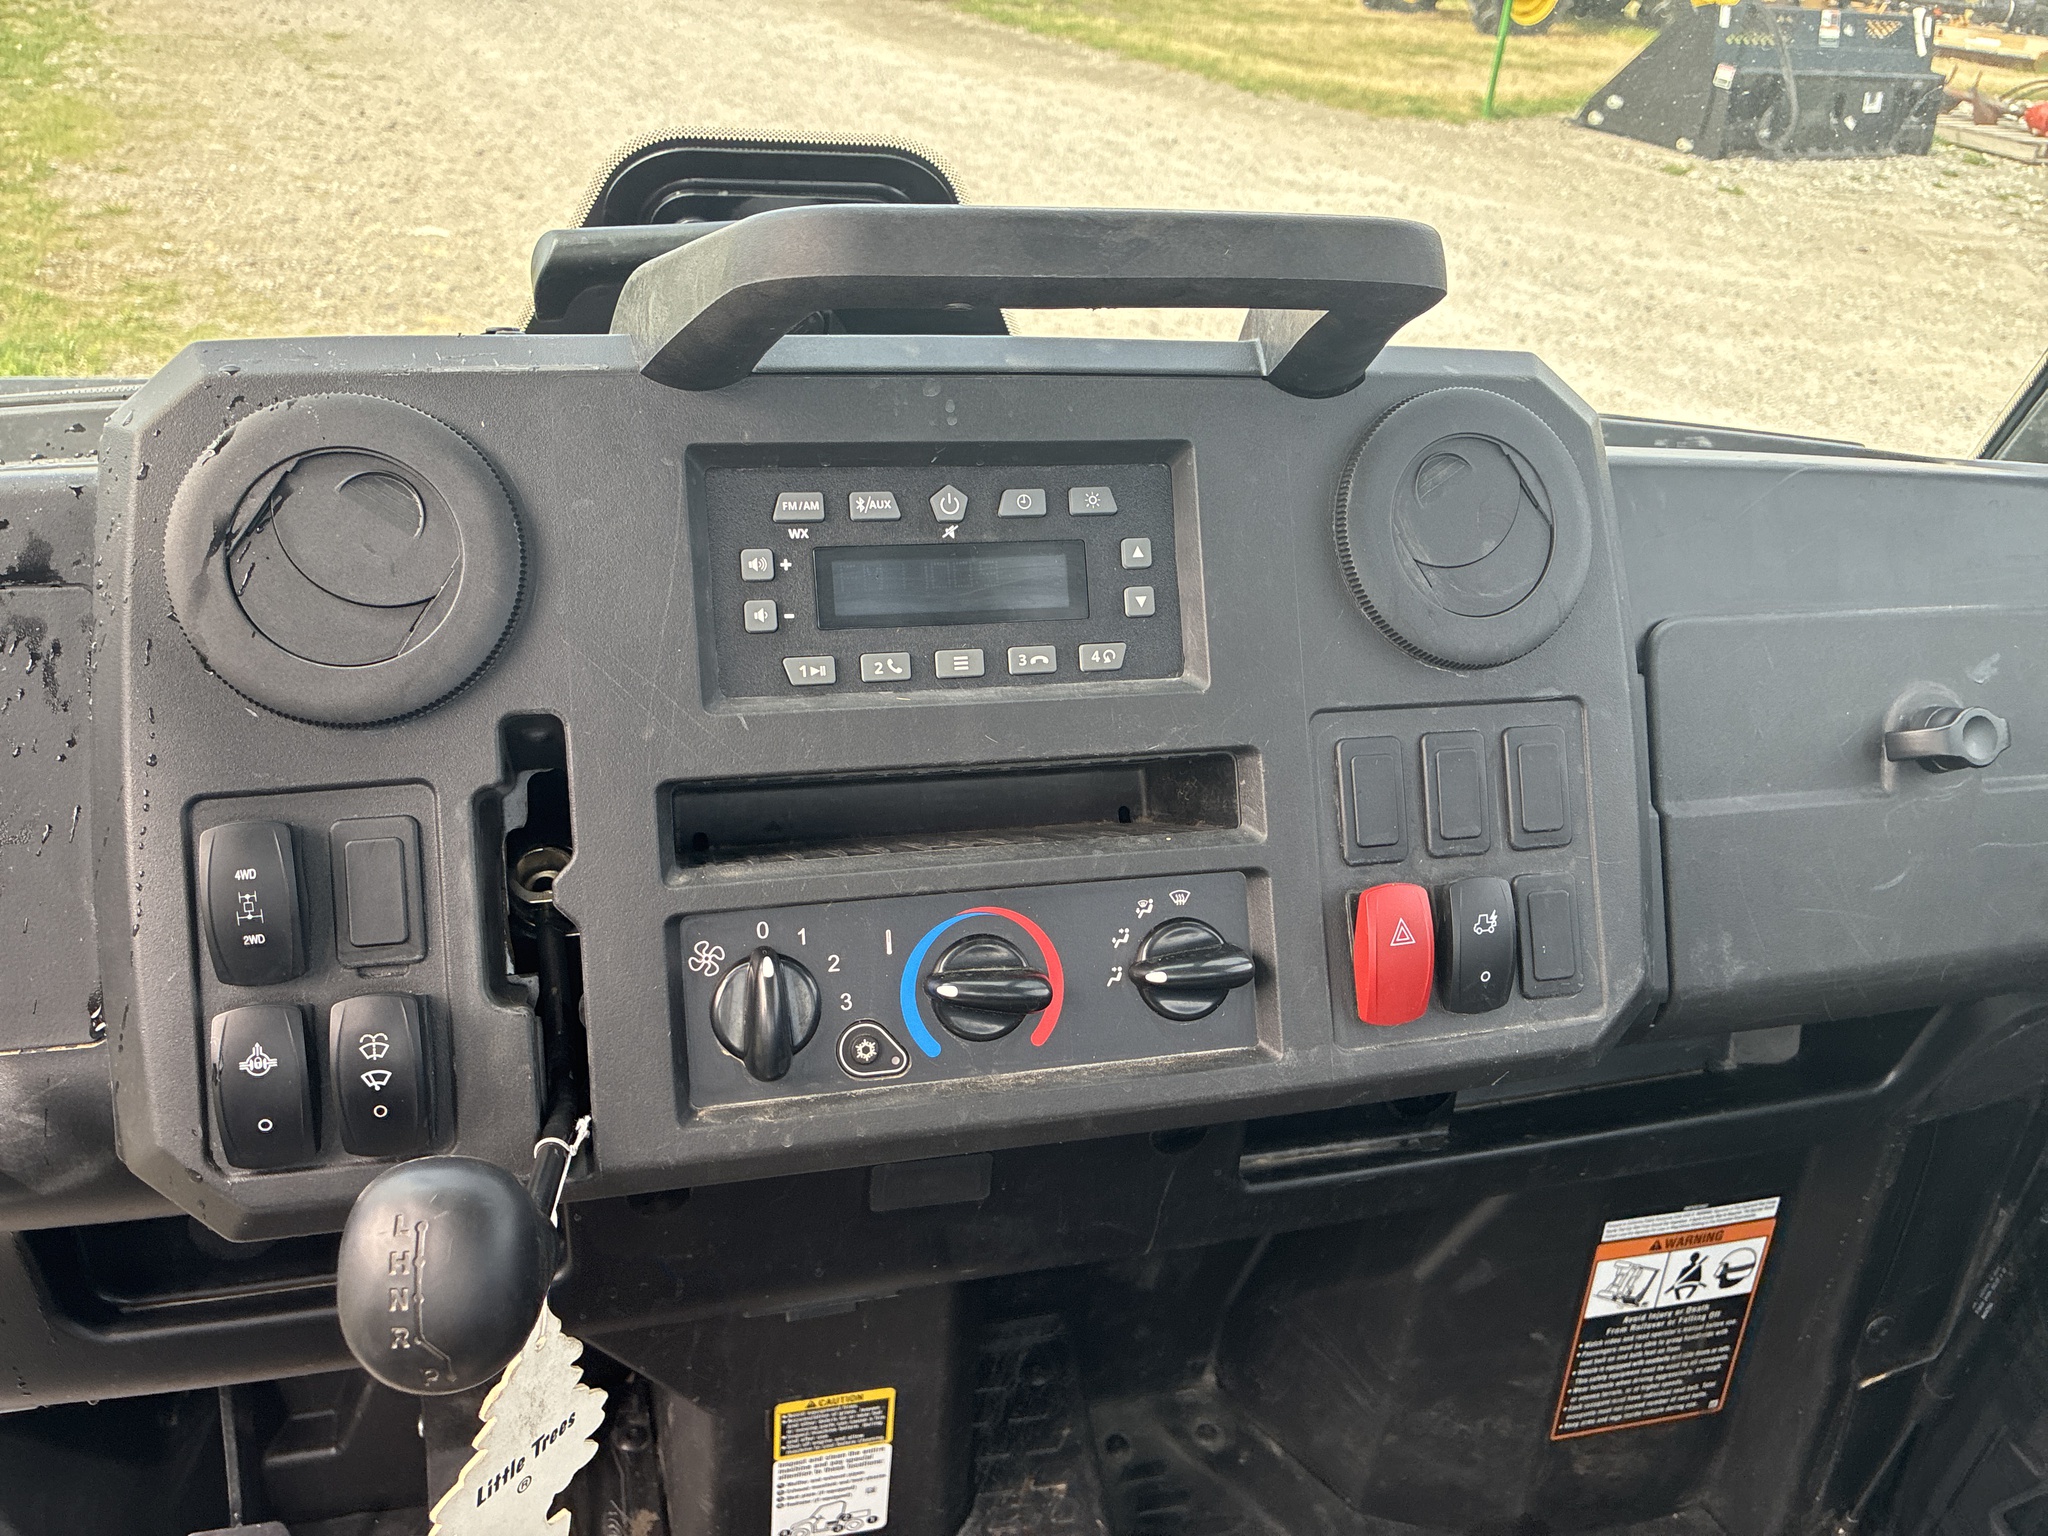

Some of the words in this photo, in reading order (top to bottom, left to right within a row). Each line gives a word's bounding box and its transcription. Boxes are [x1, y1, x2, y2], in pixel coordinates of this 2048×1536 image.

[782, 501, 820, 511] FM/AM
[788, 528, 810, 540] WX
[234, 868, 257, 880] 4WD
[243, 933, 266, 946] 2WD
[756, 921, 770, 939] 0
[797, 927, 806, 946] 1
[827, 954, 841, 973] 2
[840, 992, 853, 1011] 3
[393, 1214, 410, 1237] L
[1664, 1230, 1725, 1249] WARNING
[388, 1250, 410, 1276] H
[388, 1287, 409, 1312] N
[1622, 1313, 1647, 1325] Avoid
[391, 1327, 410, 1349] R
[1605, 1326, 1628, 1336] From
[818, 1394, 864, 1406] CAUTION
[476, 1456, 526, 1508] Little
[531, 1412, 576, 1459] Trees
